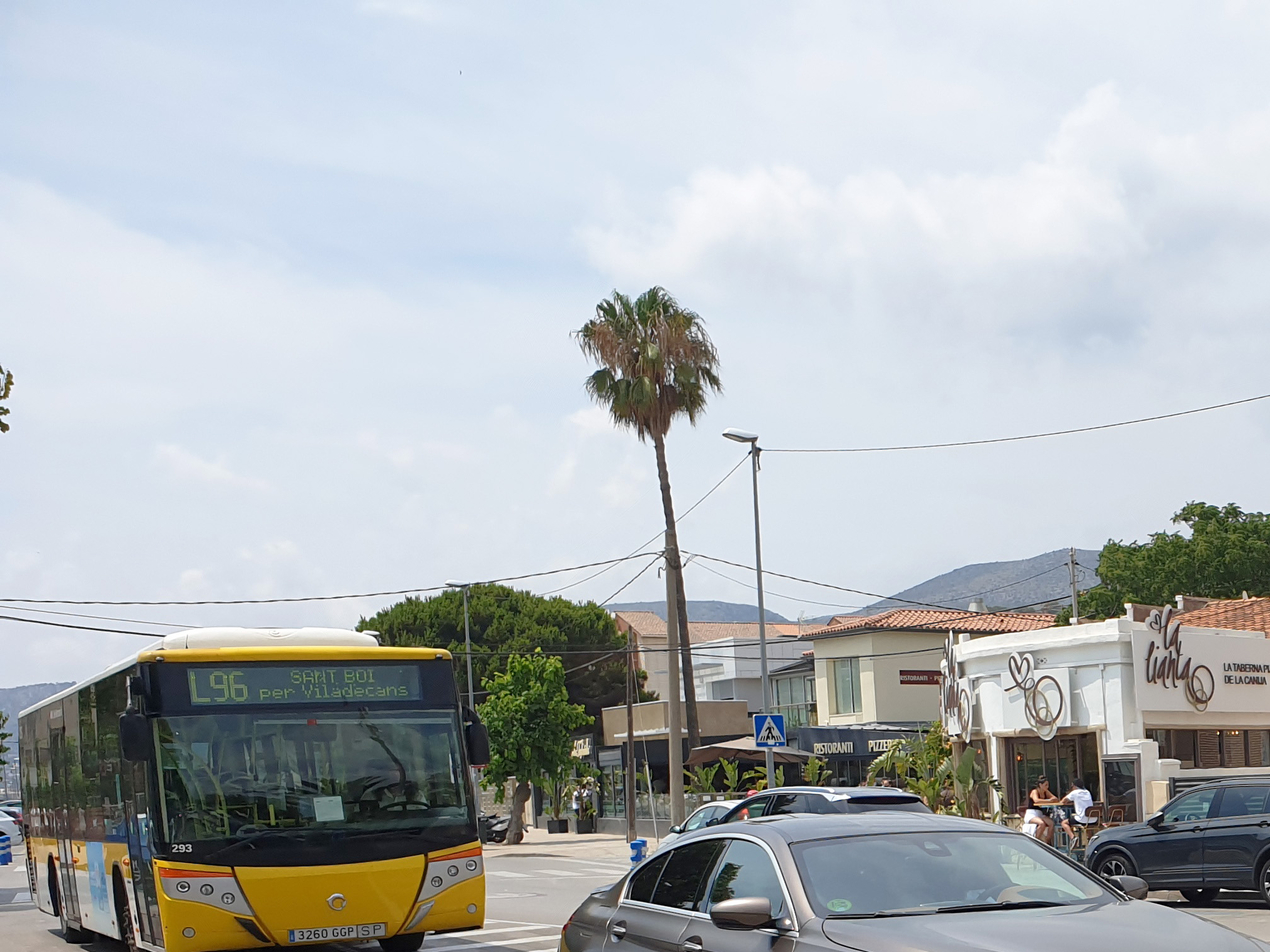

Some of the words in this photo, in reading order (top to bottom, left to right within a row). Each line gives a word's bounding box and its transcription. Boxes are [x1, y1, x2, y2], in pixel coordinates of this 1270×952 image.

[1223, 662, 1232, 672] LA
[1232, 662, 1264, 673] TABERNA
[290, 669, 336, 684] SANT
[344, 668, 376, 683] BOI
[1224, 674, 1234, 685] DE
[1234, 675, 1244, 685] LA
[189, 670, 249, 703] L96
[259, 688, 295, 701] per
[302, 683, 409, 700] Viladecans
[813, 741, 854, 755] RISTORANTI
[171, 844, 193, 853] 293
[298, 928, 328, 940] 3260
[332, 926, 355, 938] GGP
